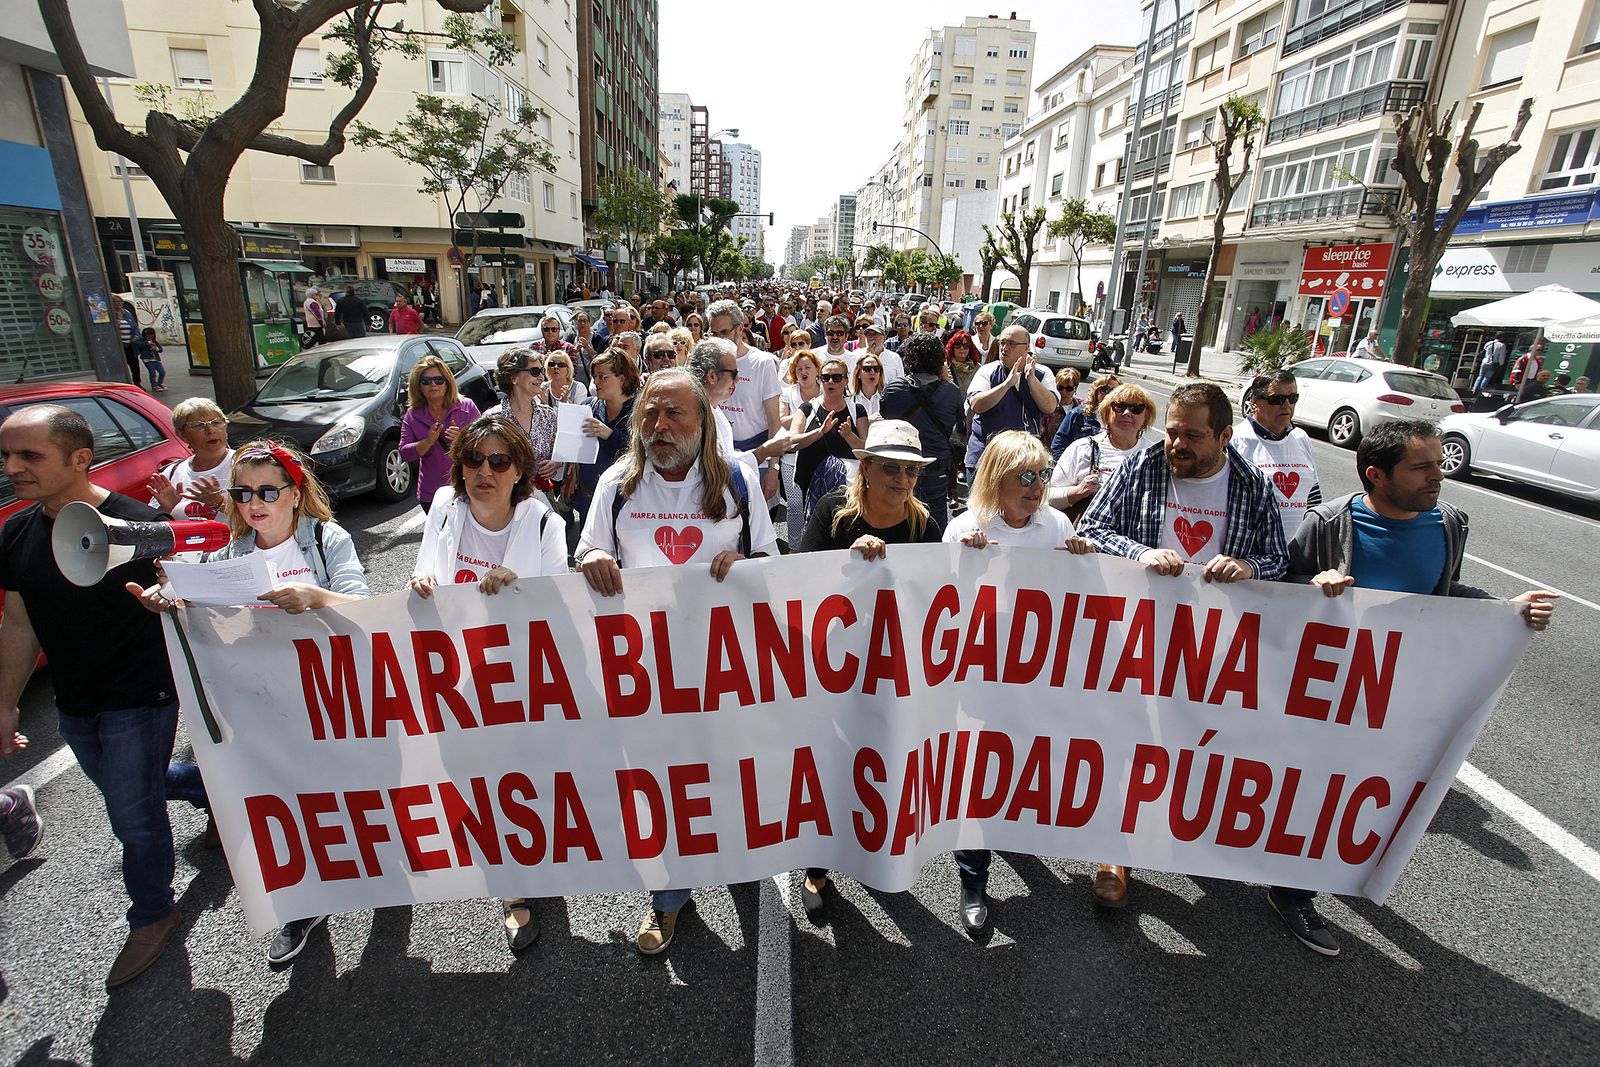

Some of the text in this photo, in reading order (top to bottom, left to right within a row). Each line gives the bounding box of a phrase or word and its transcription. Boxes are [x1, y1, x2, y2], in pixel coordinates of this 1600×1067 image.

[108, 221, 123, 231] 2A
[25, 233, 55, 250] 35%
[1322, 246, 1372, 264] sleeprice
[1351, 259, 1369, 268] basic
[1445, 264, 1497, 279] express
[40, 279, 63, 291] 40%
[49, 315, 71, 326] 50%
[658, 512, 689, 520] BLANCA
[1203, 508, 1229, 518] GADIT
[463, 556, 490, 569] BLANCA
[295, 585, 1401, 740] MAREA BLANCA GADITANA EN
[245, 729, 1427, 893] DEFENSA DE LA SANIDAD PÚBLIC
